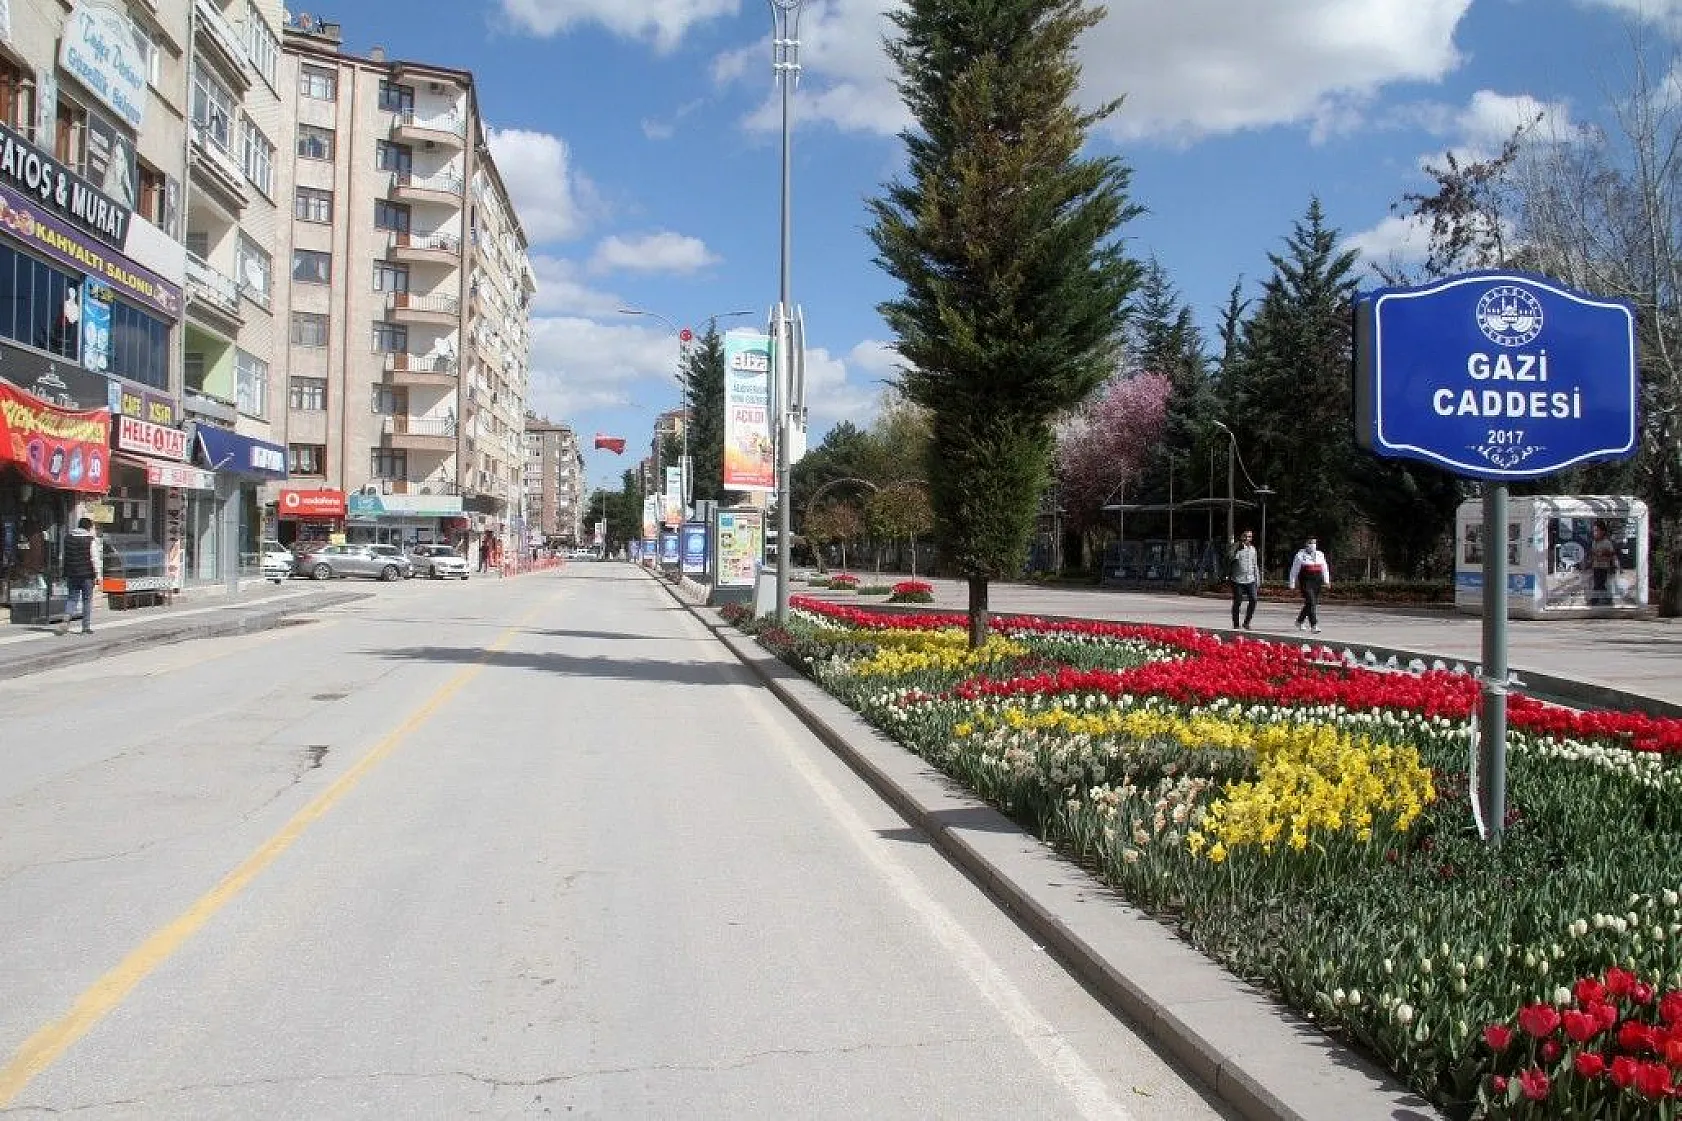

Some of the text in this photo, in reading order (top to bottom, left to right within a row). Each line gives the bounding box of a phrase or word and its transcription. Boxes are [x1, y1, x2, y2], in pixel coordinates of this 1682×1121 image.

[55, 173, 68, 208] &
[72, 183, 124, 240] MURAT
[35, 221, 104, 271] KAHVALTI
[107, 262, 153, 297] SALONU
[1467, 349, 1547, 382] GAZİ
[1433, 386, 1582, 419] CADDESİ
[122, 419, 151, 443] HELE
[165, 430, 186, 452] TAT
[1487, 429, 1525, 444] 2017
